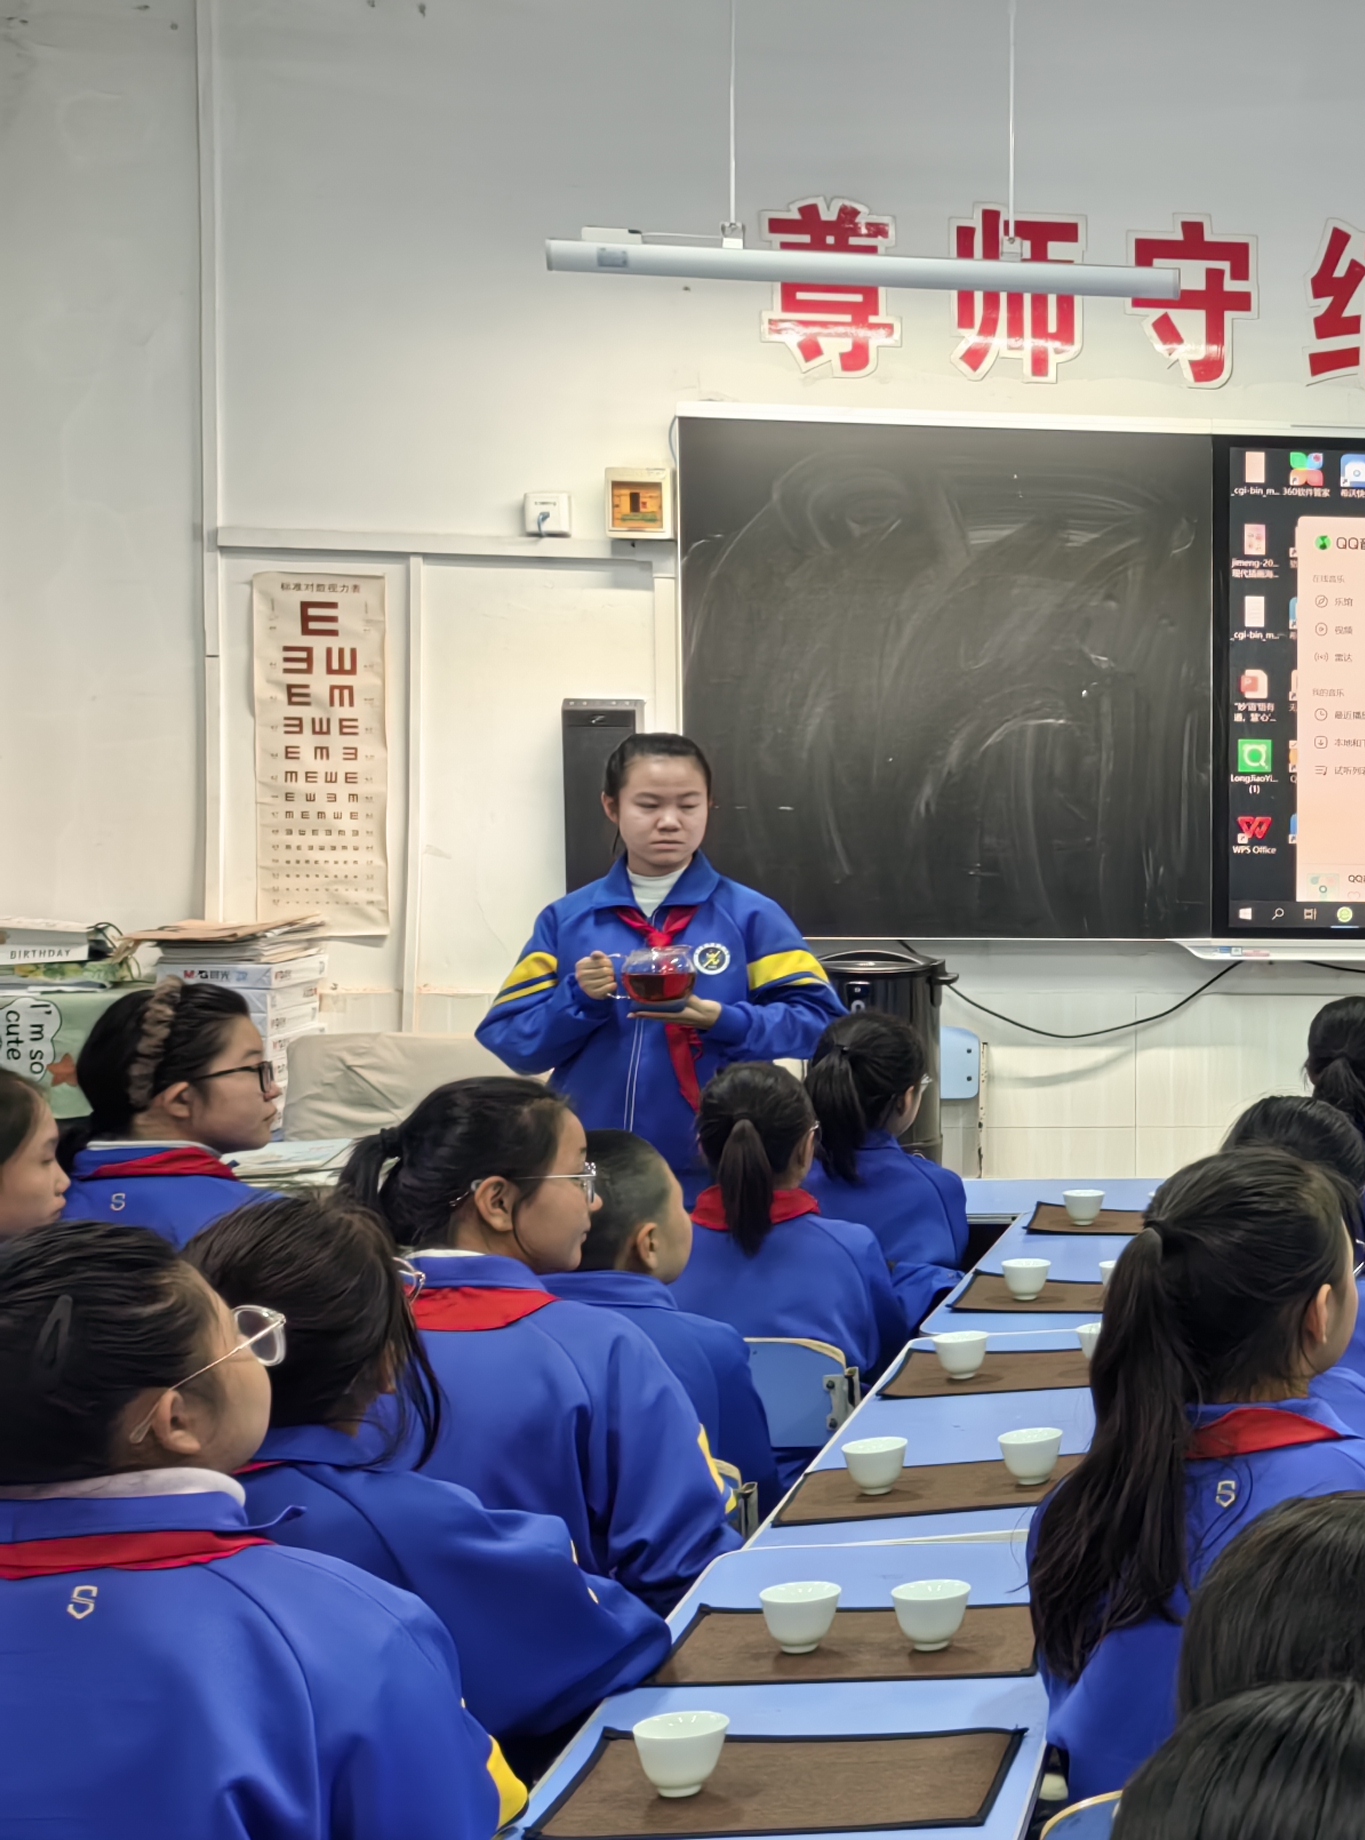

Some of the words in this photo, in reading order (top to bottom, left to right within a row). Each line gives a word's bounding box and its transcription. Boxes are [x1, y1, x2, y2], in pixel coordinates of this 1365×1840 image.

[280, 582, 361, 593] 标准对数视力表
[1334, 653, 1353, 662] 雷达
[1312, 688, 1345, 697] 我的音乐
[1233, 846, 1252, 854] WPS
[1253, 846, 1277, 854] Office
[9, 948, 72, 960] BIRTHDAY
[5, 1010, 24, 1060] cute
[30, 1049, 44, 1074] so
